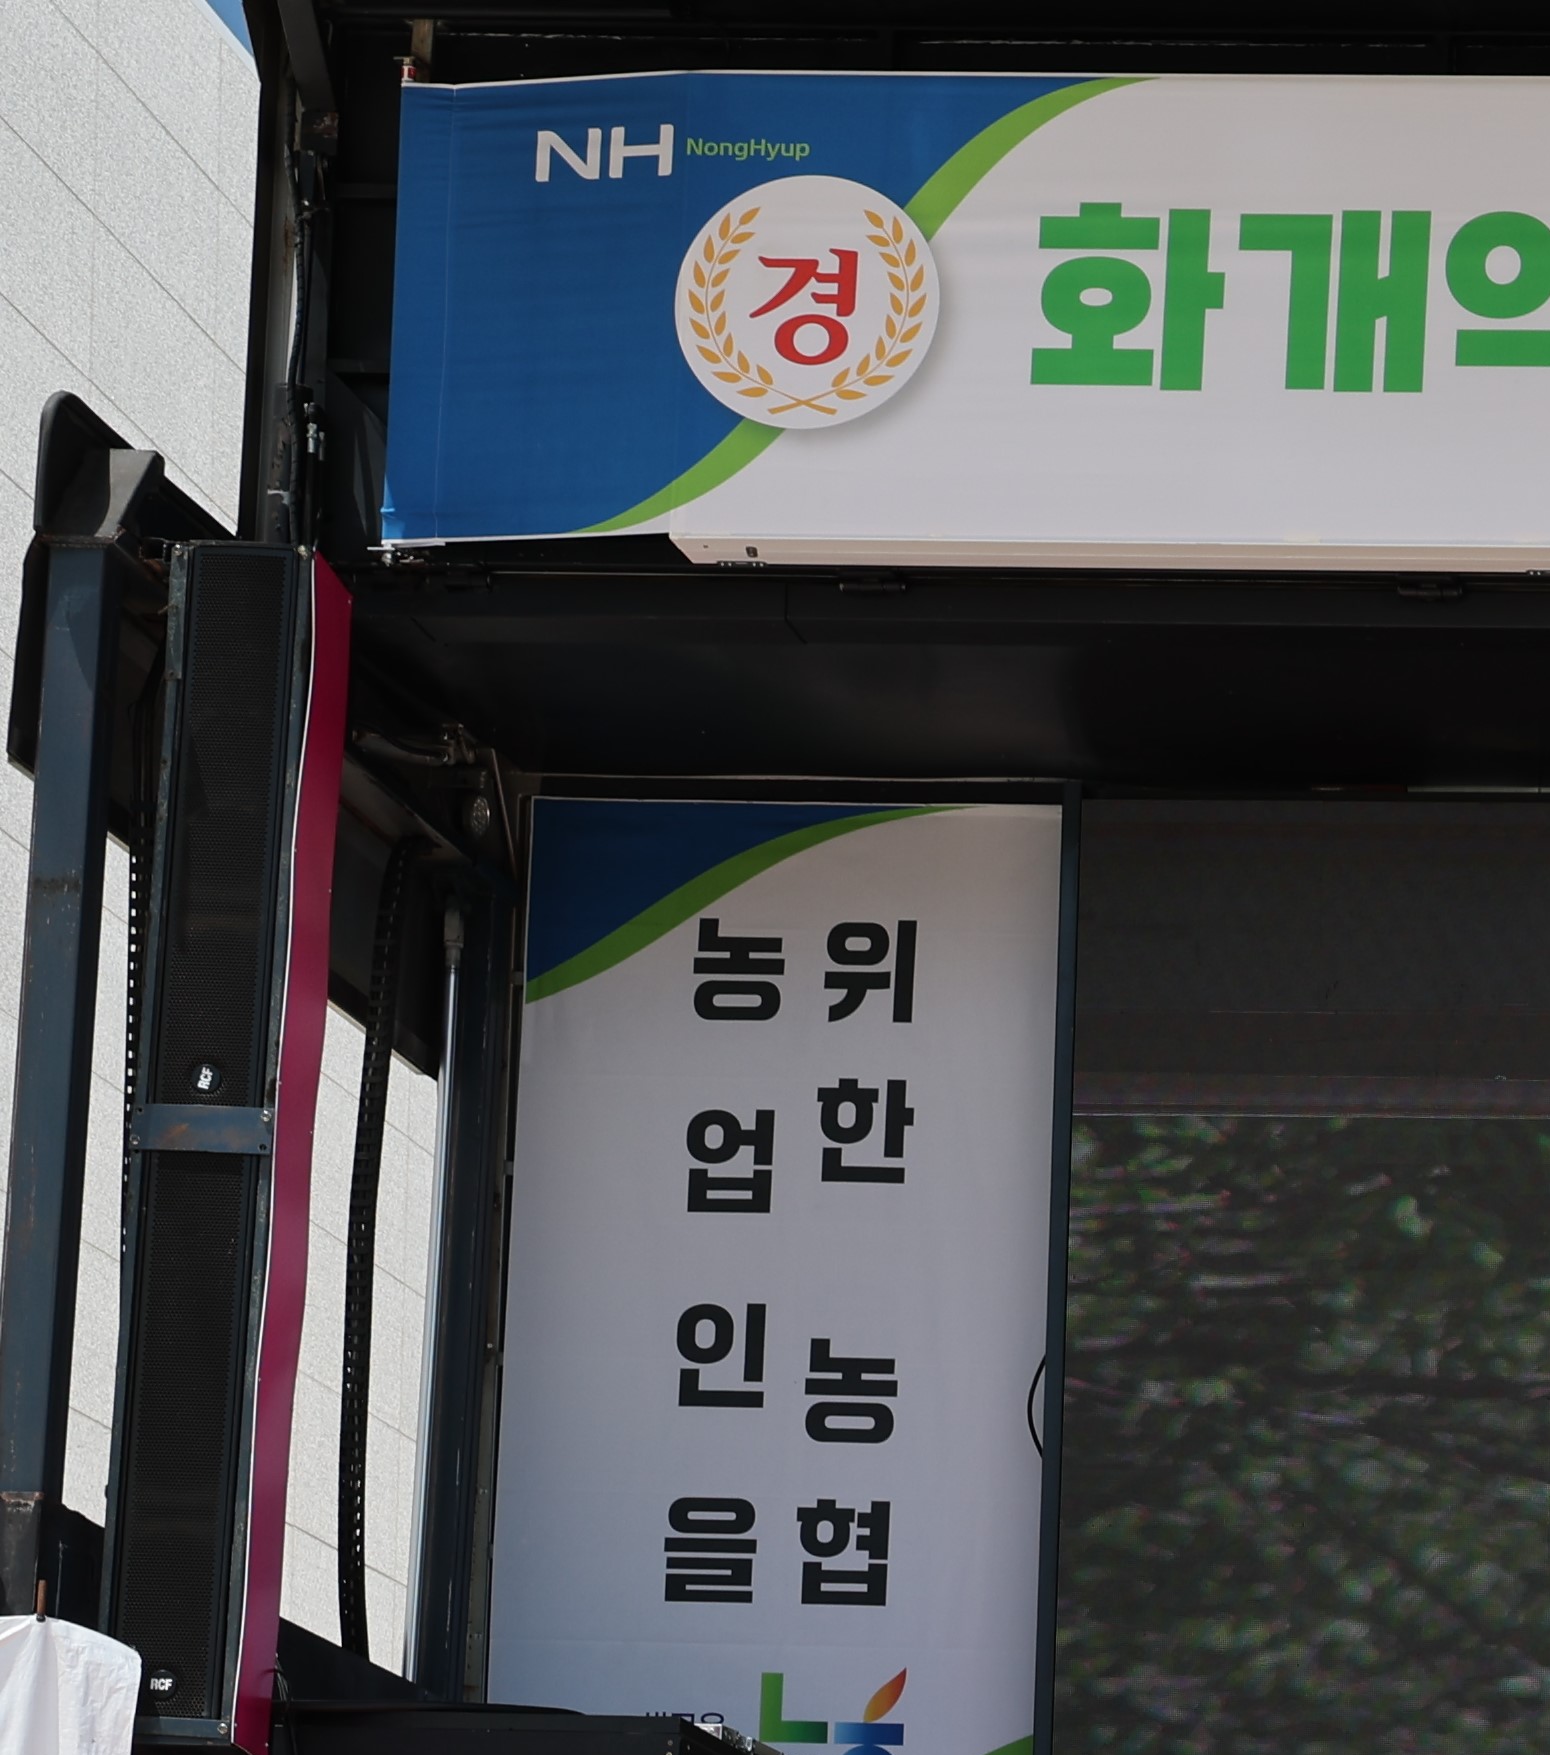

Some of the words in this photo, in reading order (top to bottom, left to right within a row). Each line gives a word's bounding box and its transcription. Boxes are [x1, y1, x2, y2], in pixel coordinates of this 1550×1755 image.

[536, 125, 673, 181] NH
[686, 138, 810, 161] NongHyup
[750, 248, 859, 366] 경
[197, 1066, 213, 1090] RCF
[817, 920, 917, 1184] 위한
[797, 1338, 898, 1606] 농협
[150, 1678, 173, 1691] RCF
